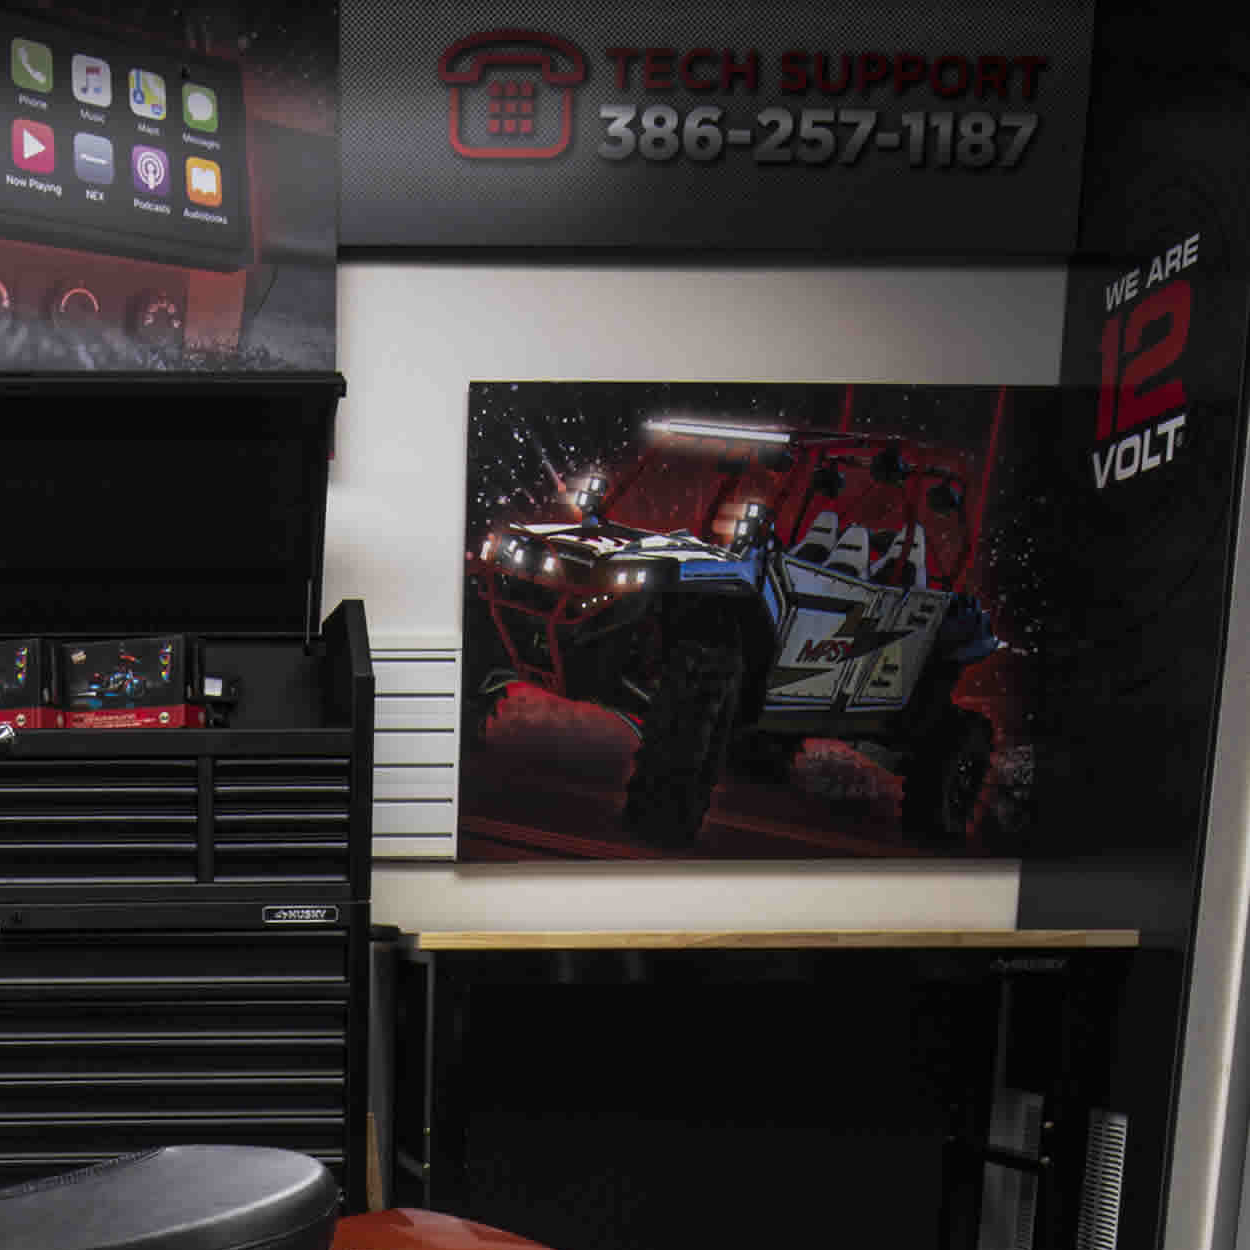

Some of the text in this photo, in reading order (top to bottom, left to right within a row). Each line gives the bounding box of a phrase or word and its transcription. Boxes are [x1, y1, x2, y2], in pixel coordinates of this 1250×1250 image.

[606, 47, 1047, 98] TECH SUPPORT
[597, 103, 1040, 170] 386-257-1187
[5, 174, 63, 198] Now Playing
[1105, 231, 1201, 313] WE ARE
[1096, 280, 1192, 441] 12
[1092, 413, 1187, 489] VOLT
